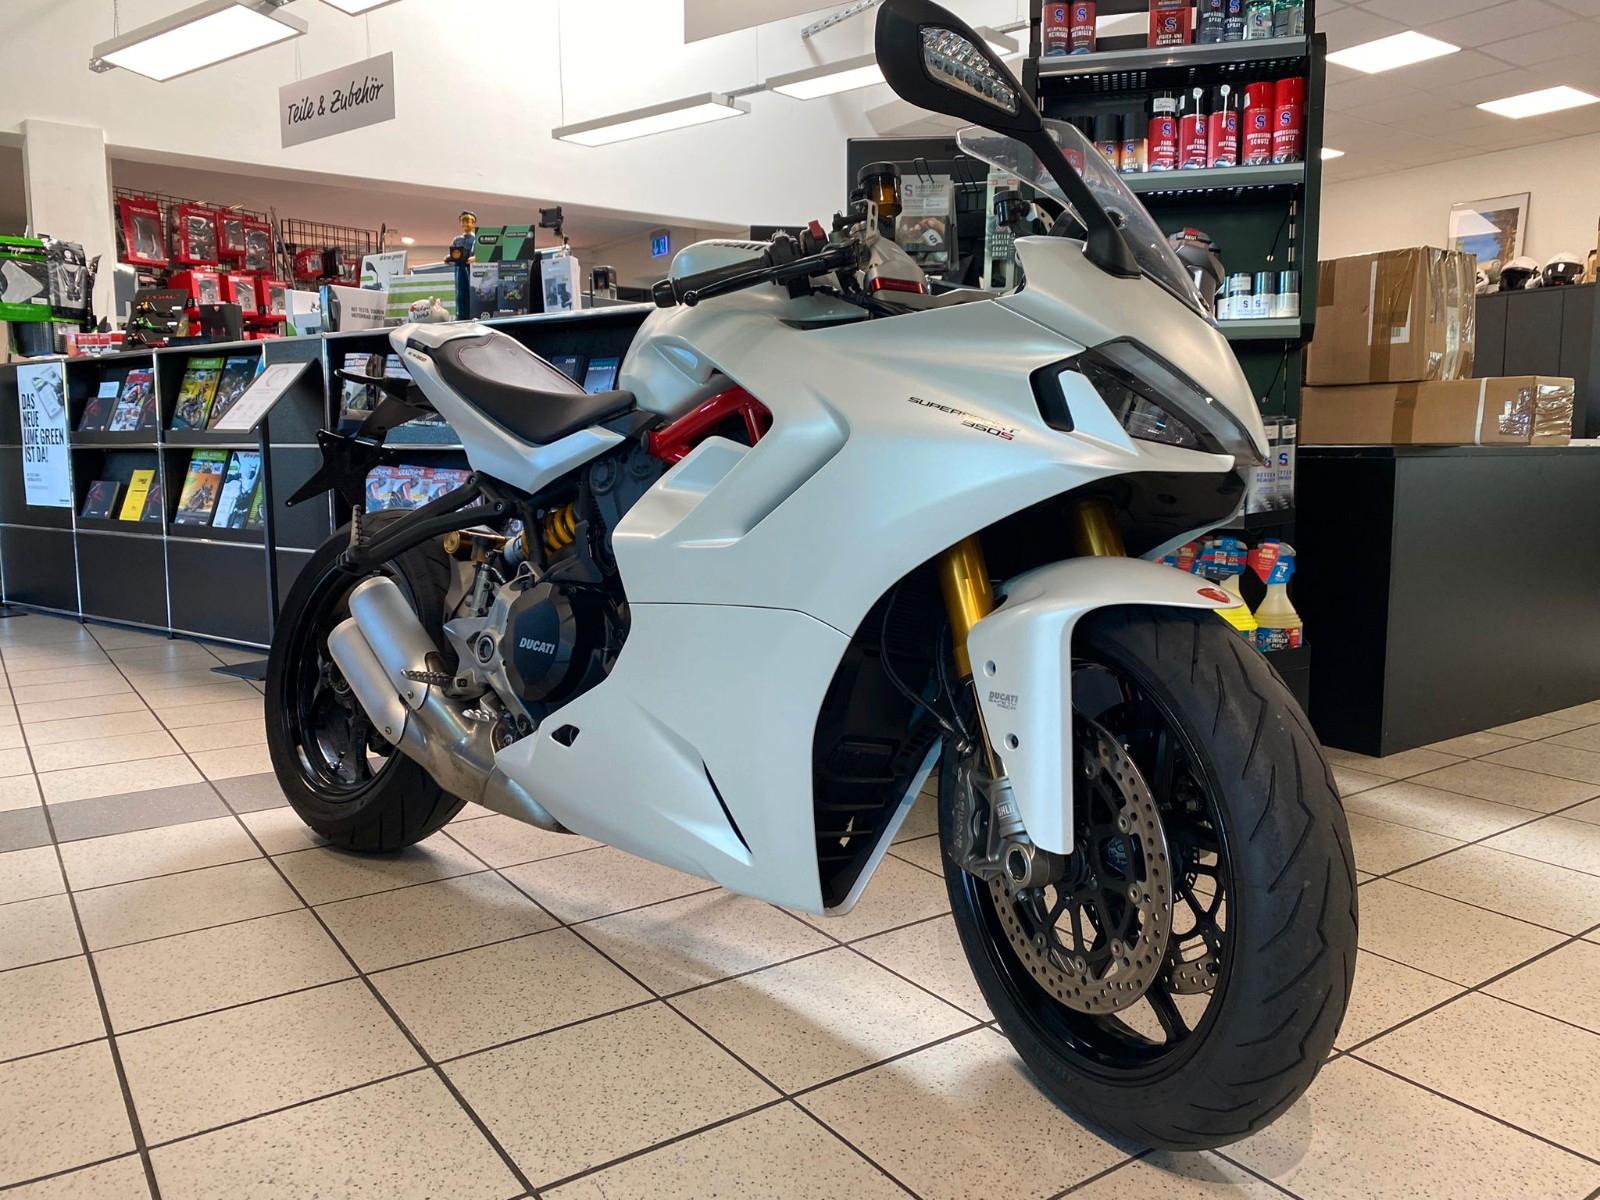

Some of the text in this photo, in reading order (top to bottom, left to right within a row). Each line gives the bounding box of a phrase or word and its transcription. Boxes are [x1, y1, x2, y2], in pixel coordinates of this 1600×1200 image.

[288, 76, 384, 125] Teile & Zubehör
[1255, 114, 1266, 129] S
[1280, 111, 1291, 127] S
[21, 393, 36, 410] DAS
[22, 411, 40, 427] NEUE
[24, 428, 65, 445] LIME GREEN
[961, 419, 1015, 441] 950S
[25, 446, 49, 463] IST DA!
[1278, 452, 1288, 466] S
[519, 637, 556, 655] DUCATI
[989, 691, 1019, 704] DUCATI
